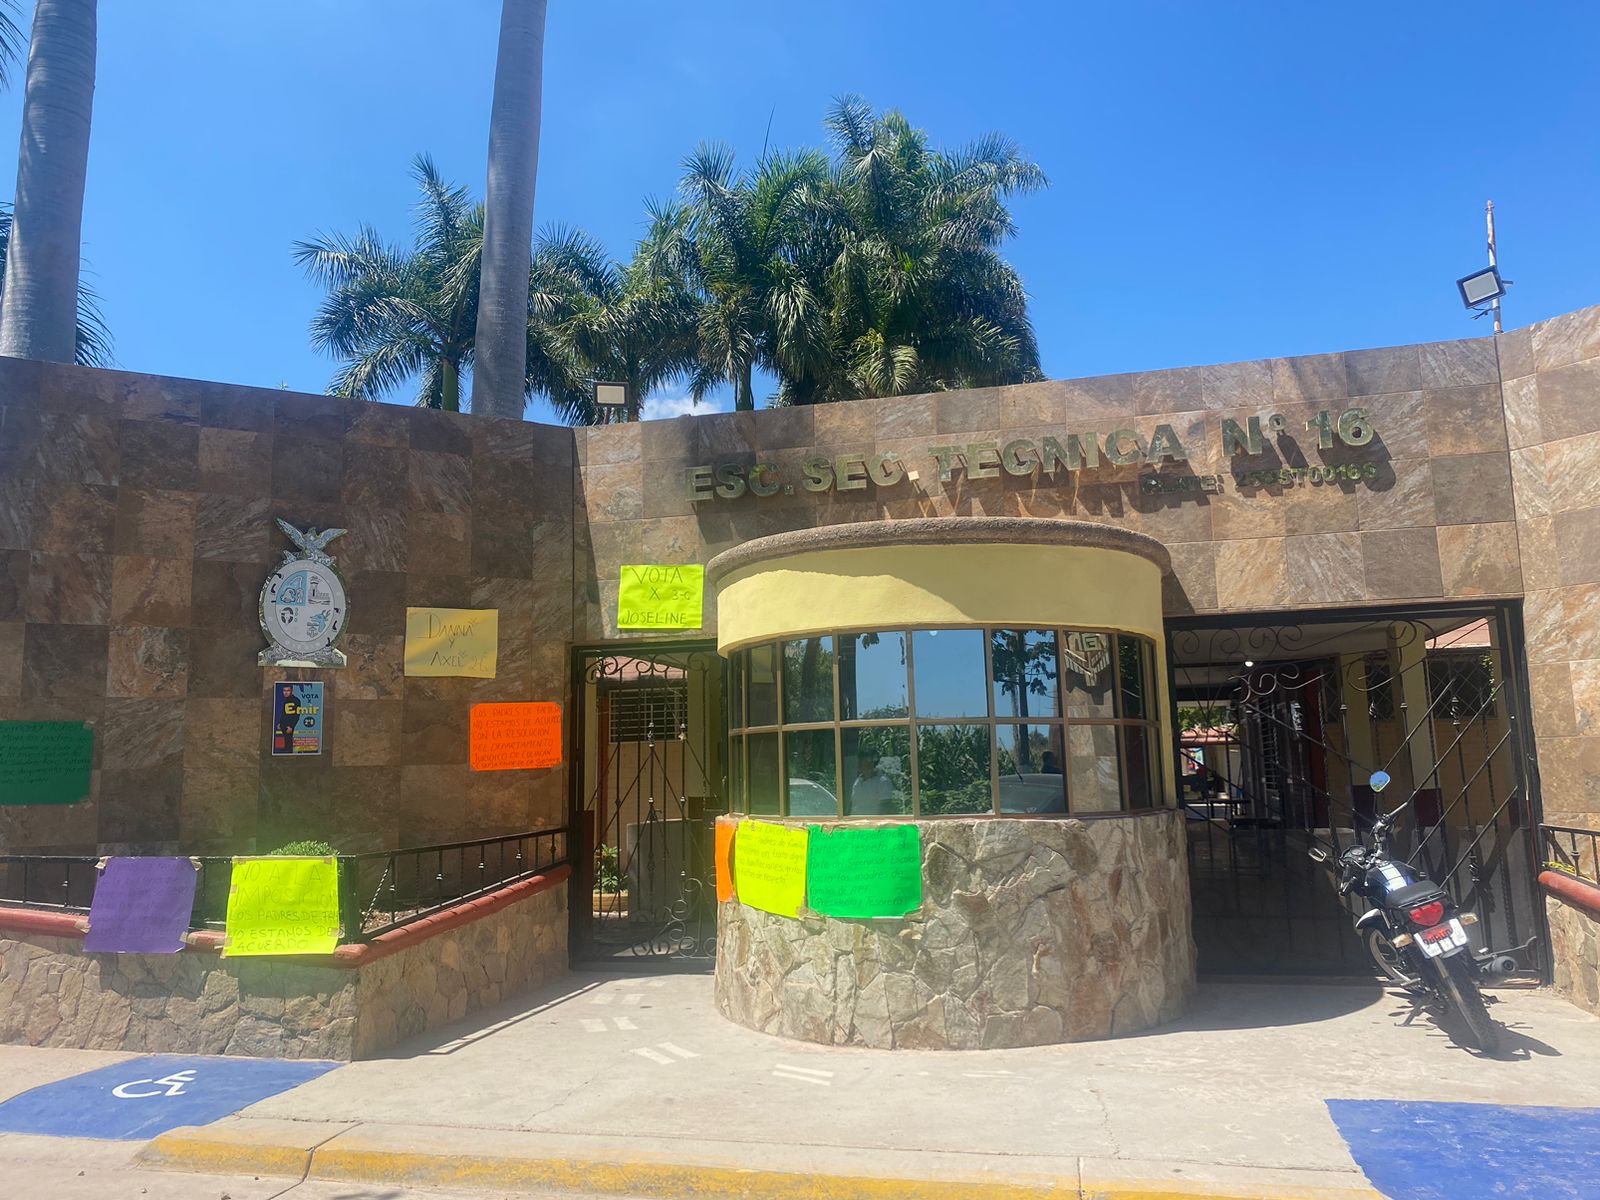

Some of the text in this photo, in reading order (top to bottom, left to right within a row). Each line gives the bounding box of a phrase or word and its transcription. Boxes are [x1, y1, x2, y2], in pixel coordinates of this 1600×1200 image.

[685, 463, 794, 503] ESC.
[802, 451, 920, 493] SEC.
[930, 423, 1190, 482] TECNICA
[1305, 406, 1375, 450] 16
[631, 566, 684, 585] VOTA
[622, 608, 688, 625] JOSELINE
[284, 702, 320, 715] Emir
[235, 861, 322, 886] NO A LA
[257, 909, 301, 922] PADRES
[237, 937, 309, 953] ACUERDO
